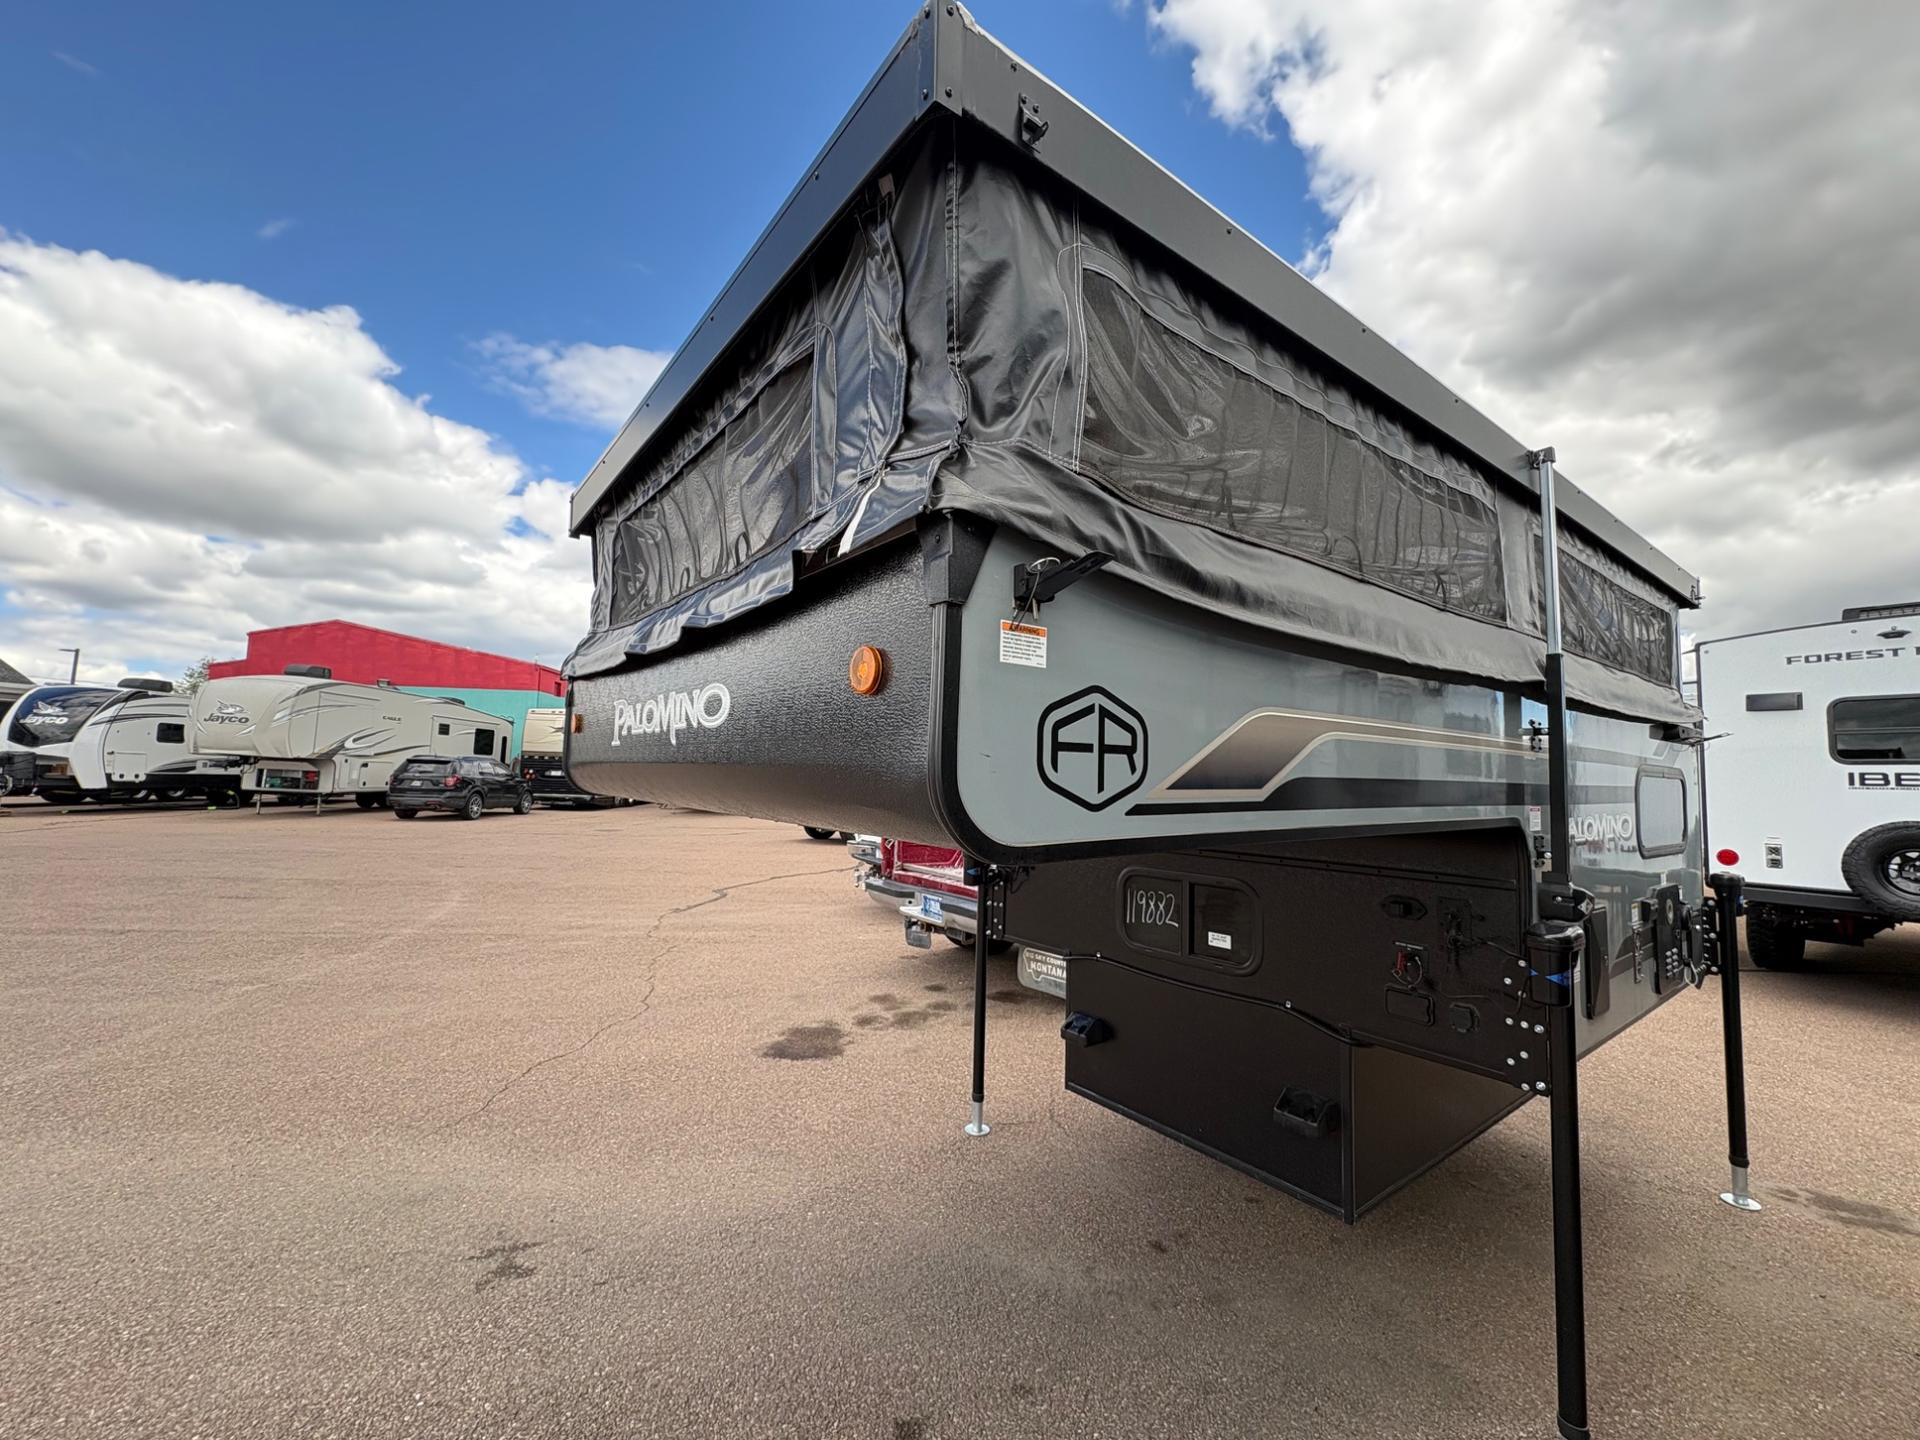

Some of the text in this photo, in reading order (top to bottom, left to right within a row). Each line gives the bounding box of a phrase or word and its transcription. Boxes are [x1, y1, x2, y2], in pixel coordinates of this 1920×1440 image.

[1785, 647, 1906, 665] FOREST
[19, 713, 69, 726] Jayco
[203, 712, 250, 725] Jayco
[611, 682, 731, 747] PALOMINO
[1568, 813, 1633, 847] ALOMINO
[1126, 887, 1179, 929] 119882
